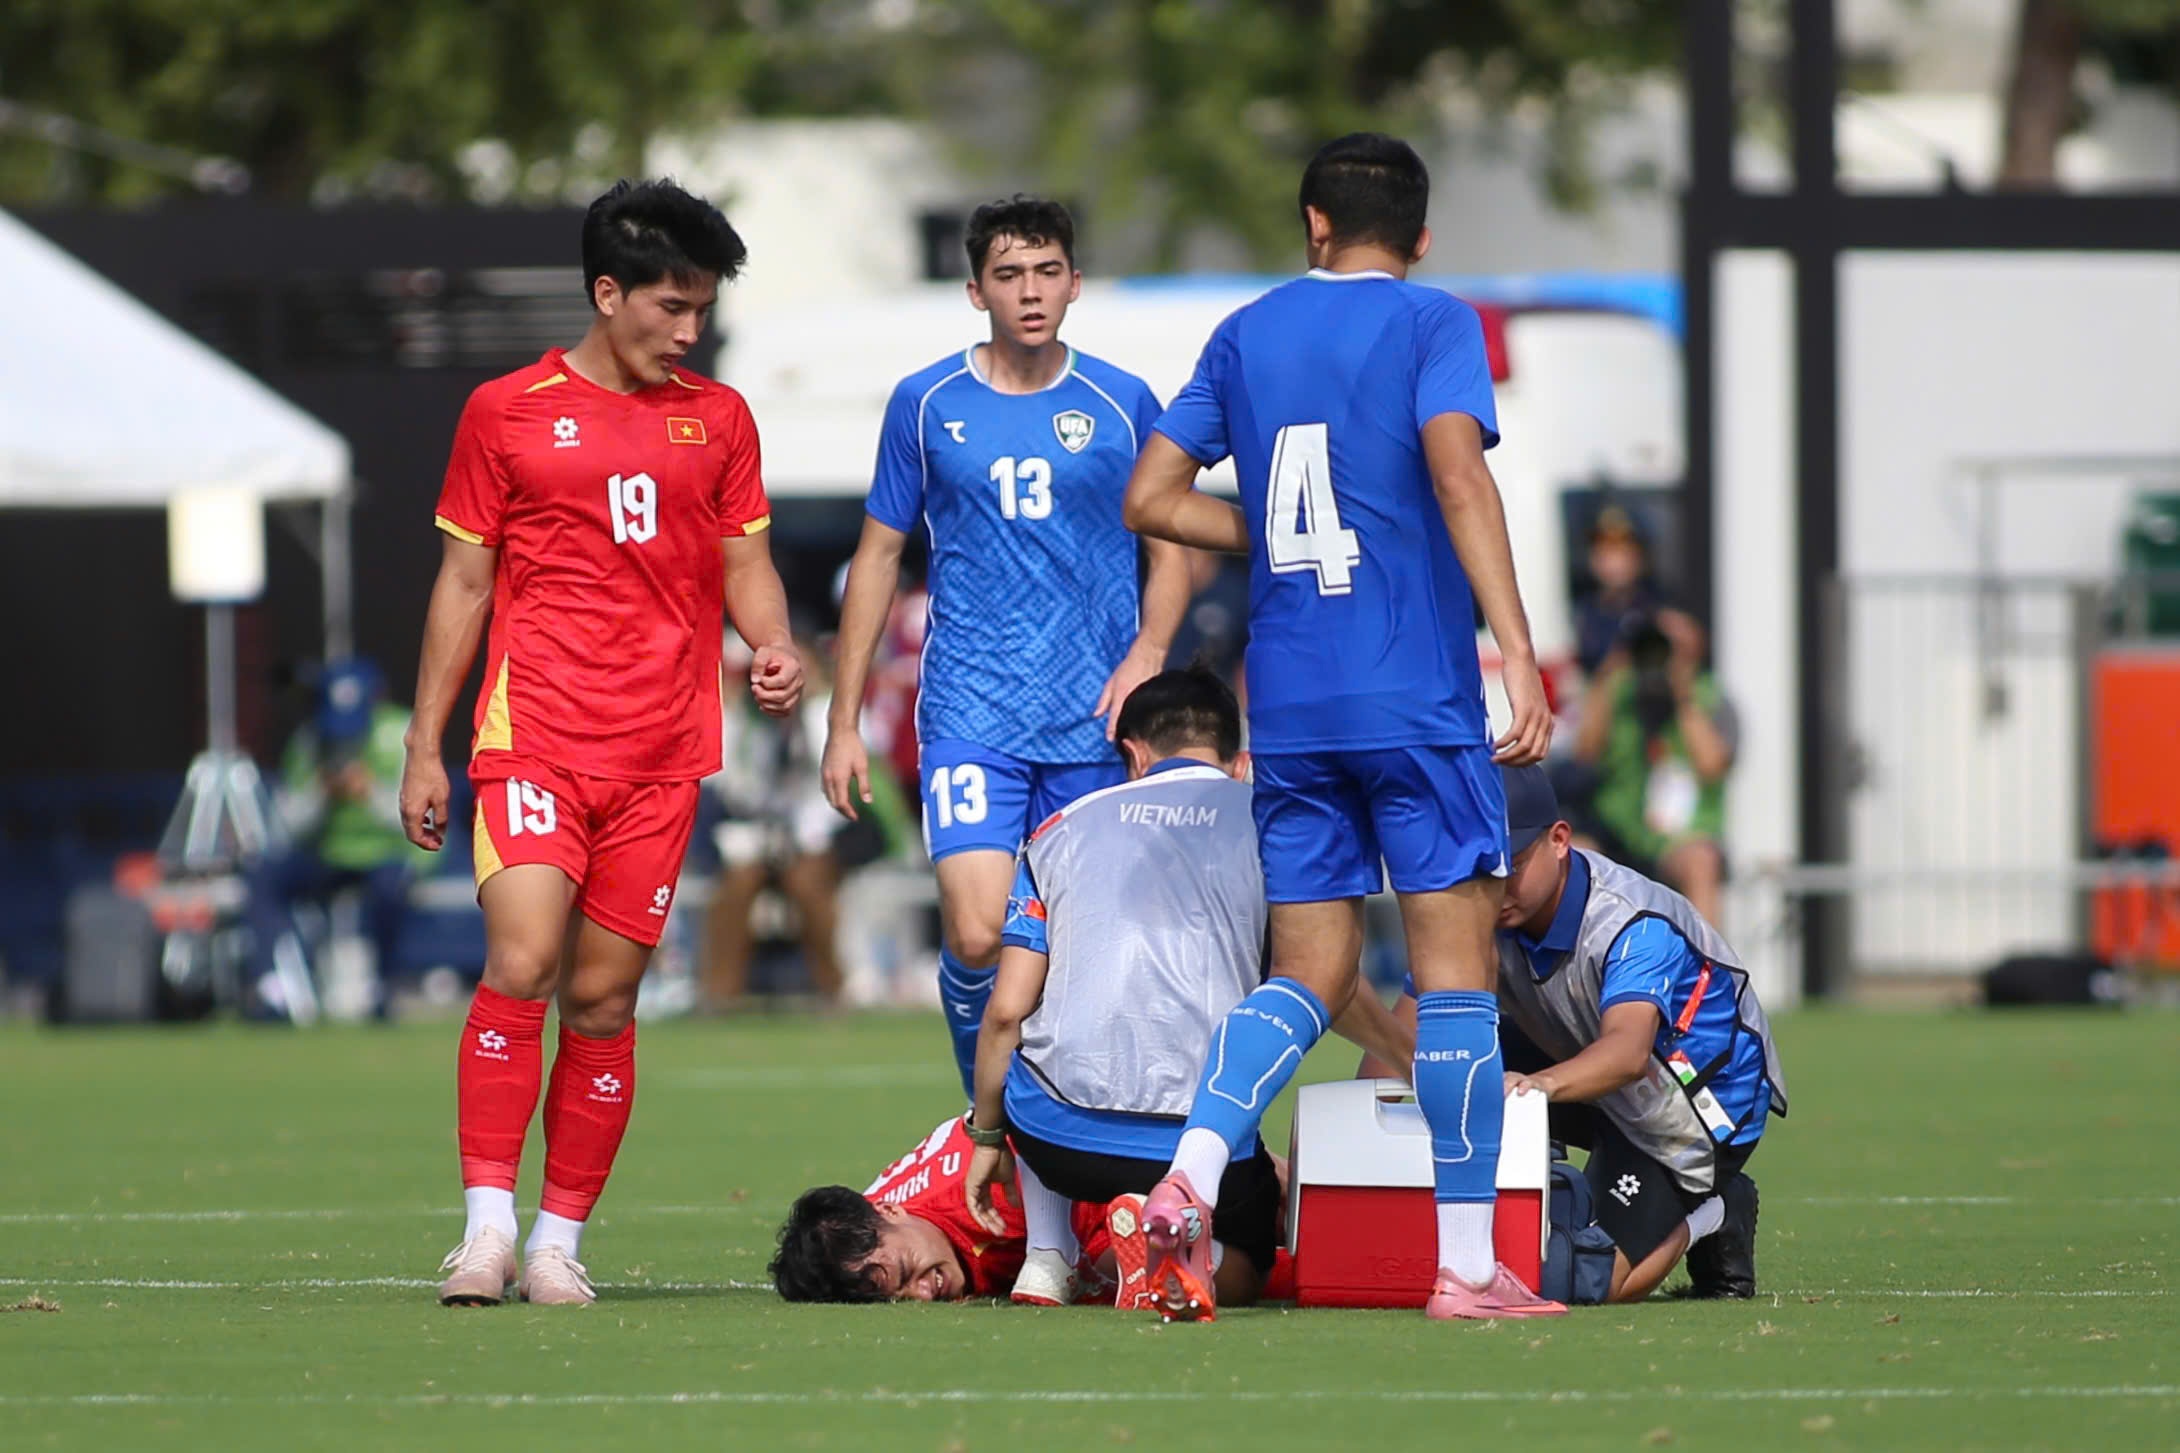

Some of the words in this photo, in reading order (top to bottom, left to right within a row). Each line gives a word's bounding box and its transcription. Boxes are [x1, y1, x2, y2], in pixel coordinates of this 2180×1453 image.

[1060, 416, 1088, 434] UFA
[607, 473, 657, 544] 19
[990, 456, 1052, 519] 13
[1266, 422, 1361, 596] 4
[506, 776, 557, 837] 19
[930, 763, 988, 828] 13
[1119, 803, 1217, 827] VIETNAM
